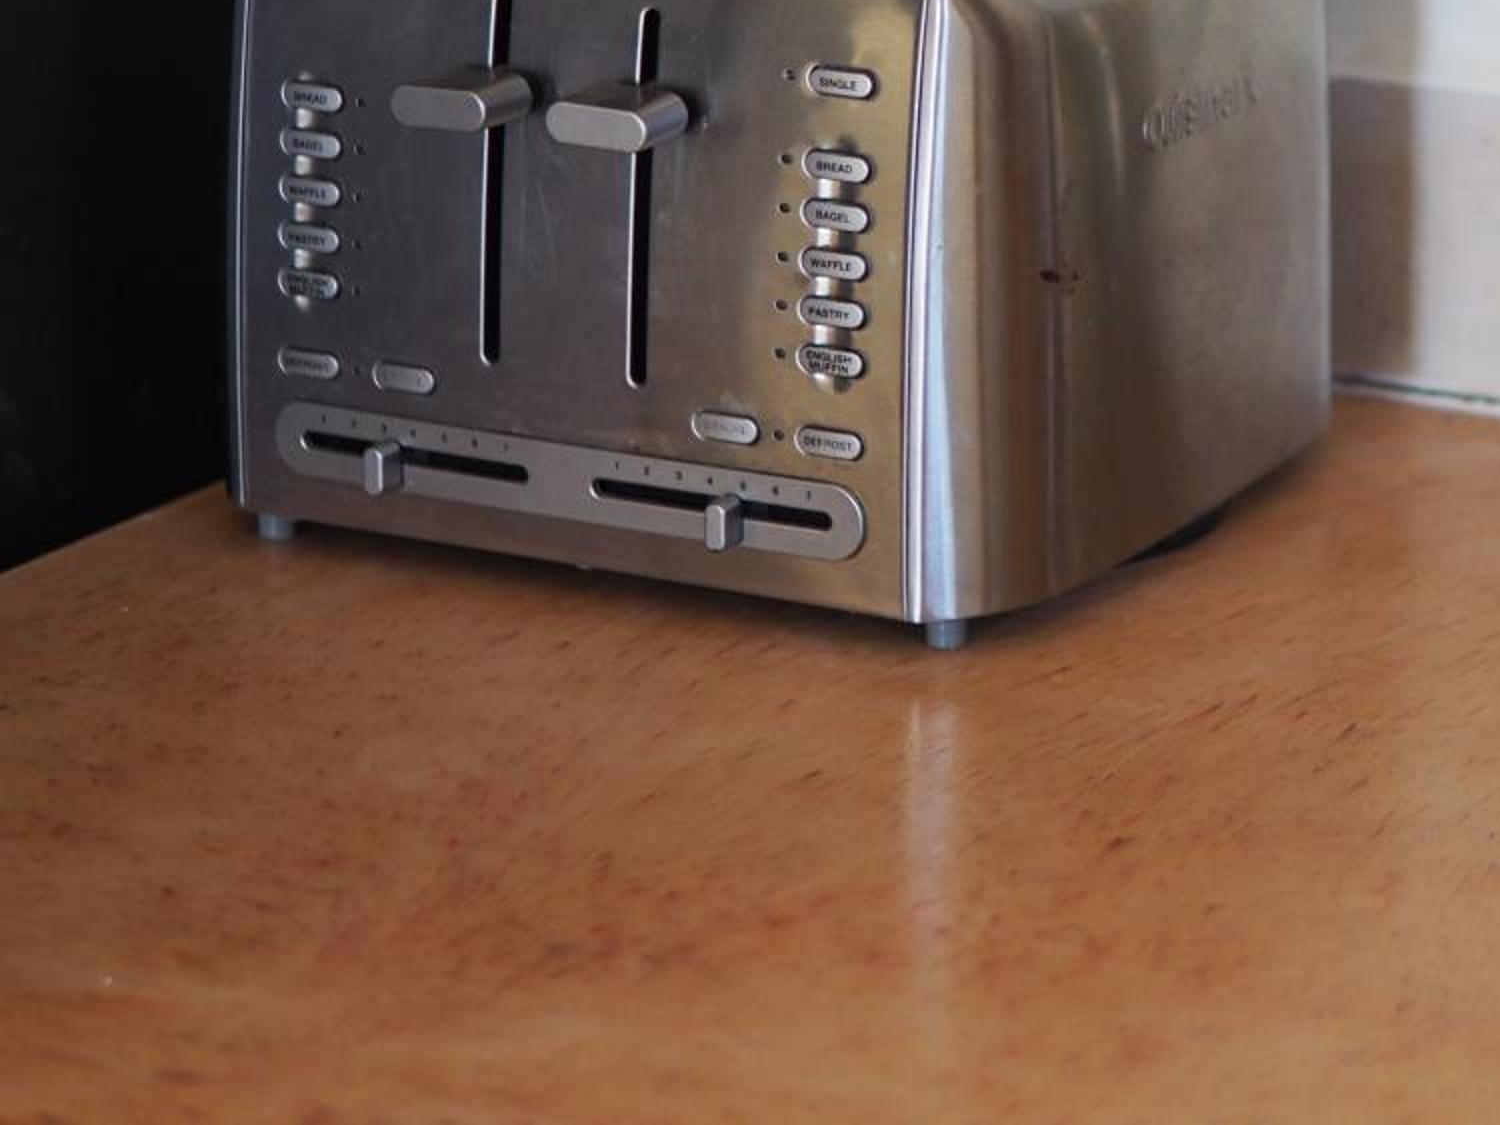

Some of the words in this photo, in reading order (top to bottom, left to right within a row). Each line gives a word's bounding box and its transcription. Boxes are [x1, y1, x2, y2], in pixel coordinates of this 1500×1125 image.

[818, 76, 858, 92] SINGLE
[815, 160, 854, 174] BREAD
[815, 208, 850, 223] BAGEL
[809, 257, 853, 272] WAFFLE
[807, 307, 850, 321] PASTRY
[805, 350, 853, 363] ENGLISH
[809, 360, 850, 374] MUFFIN
[803, 435, 854, 452] DEFROST
